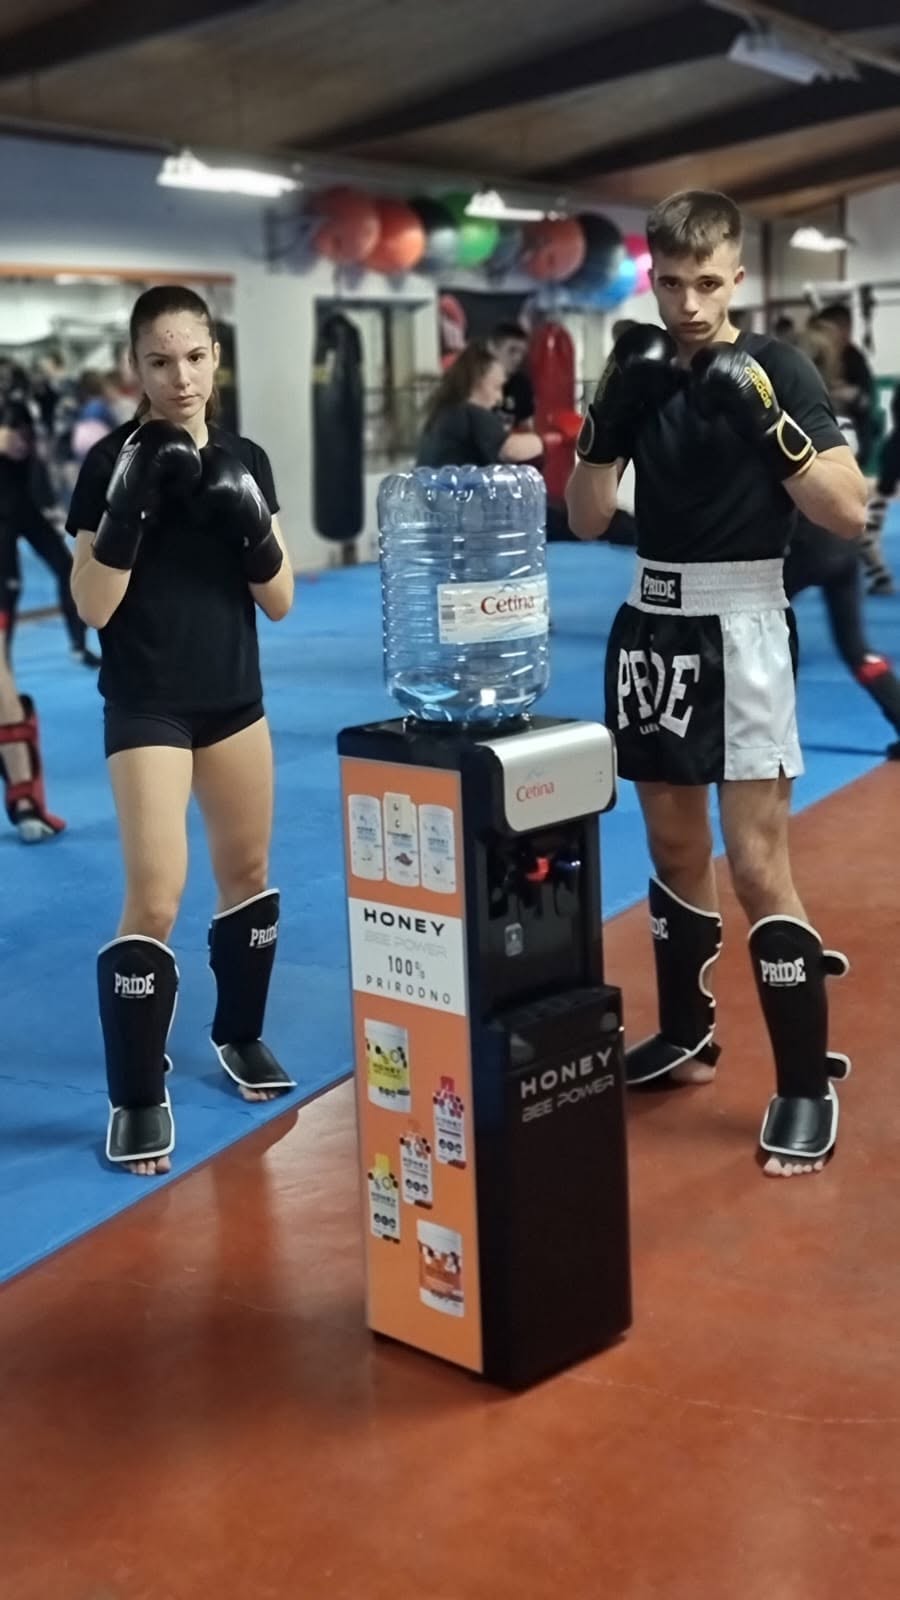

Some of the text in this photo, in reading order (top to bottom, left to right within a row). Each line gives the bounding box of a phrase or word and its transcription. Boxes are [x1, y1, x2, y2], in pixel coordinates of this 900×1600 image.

[643, 574, 676, 599] PRIDE
[480, 594, 535, 616] Cetina
[617, 647, 700, 738] PRDE
[516, 781, 554, 802] Cetina
[363, 907, 445, 936] HONEY
[388, 955, 426, 980] 100%
[760, 957, 806, 983] PRIDE
[114, 973, 155, 995] PRIDE
[366, 974, 451, 1005] PRIRODNO
[521, 1047, 613, 1099] HONEY
[522, 1074, 615, 1123] BEE POWER
